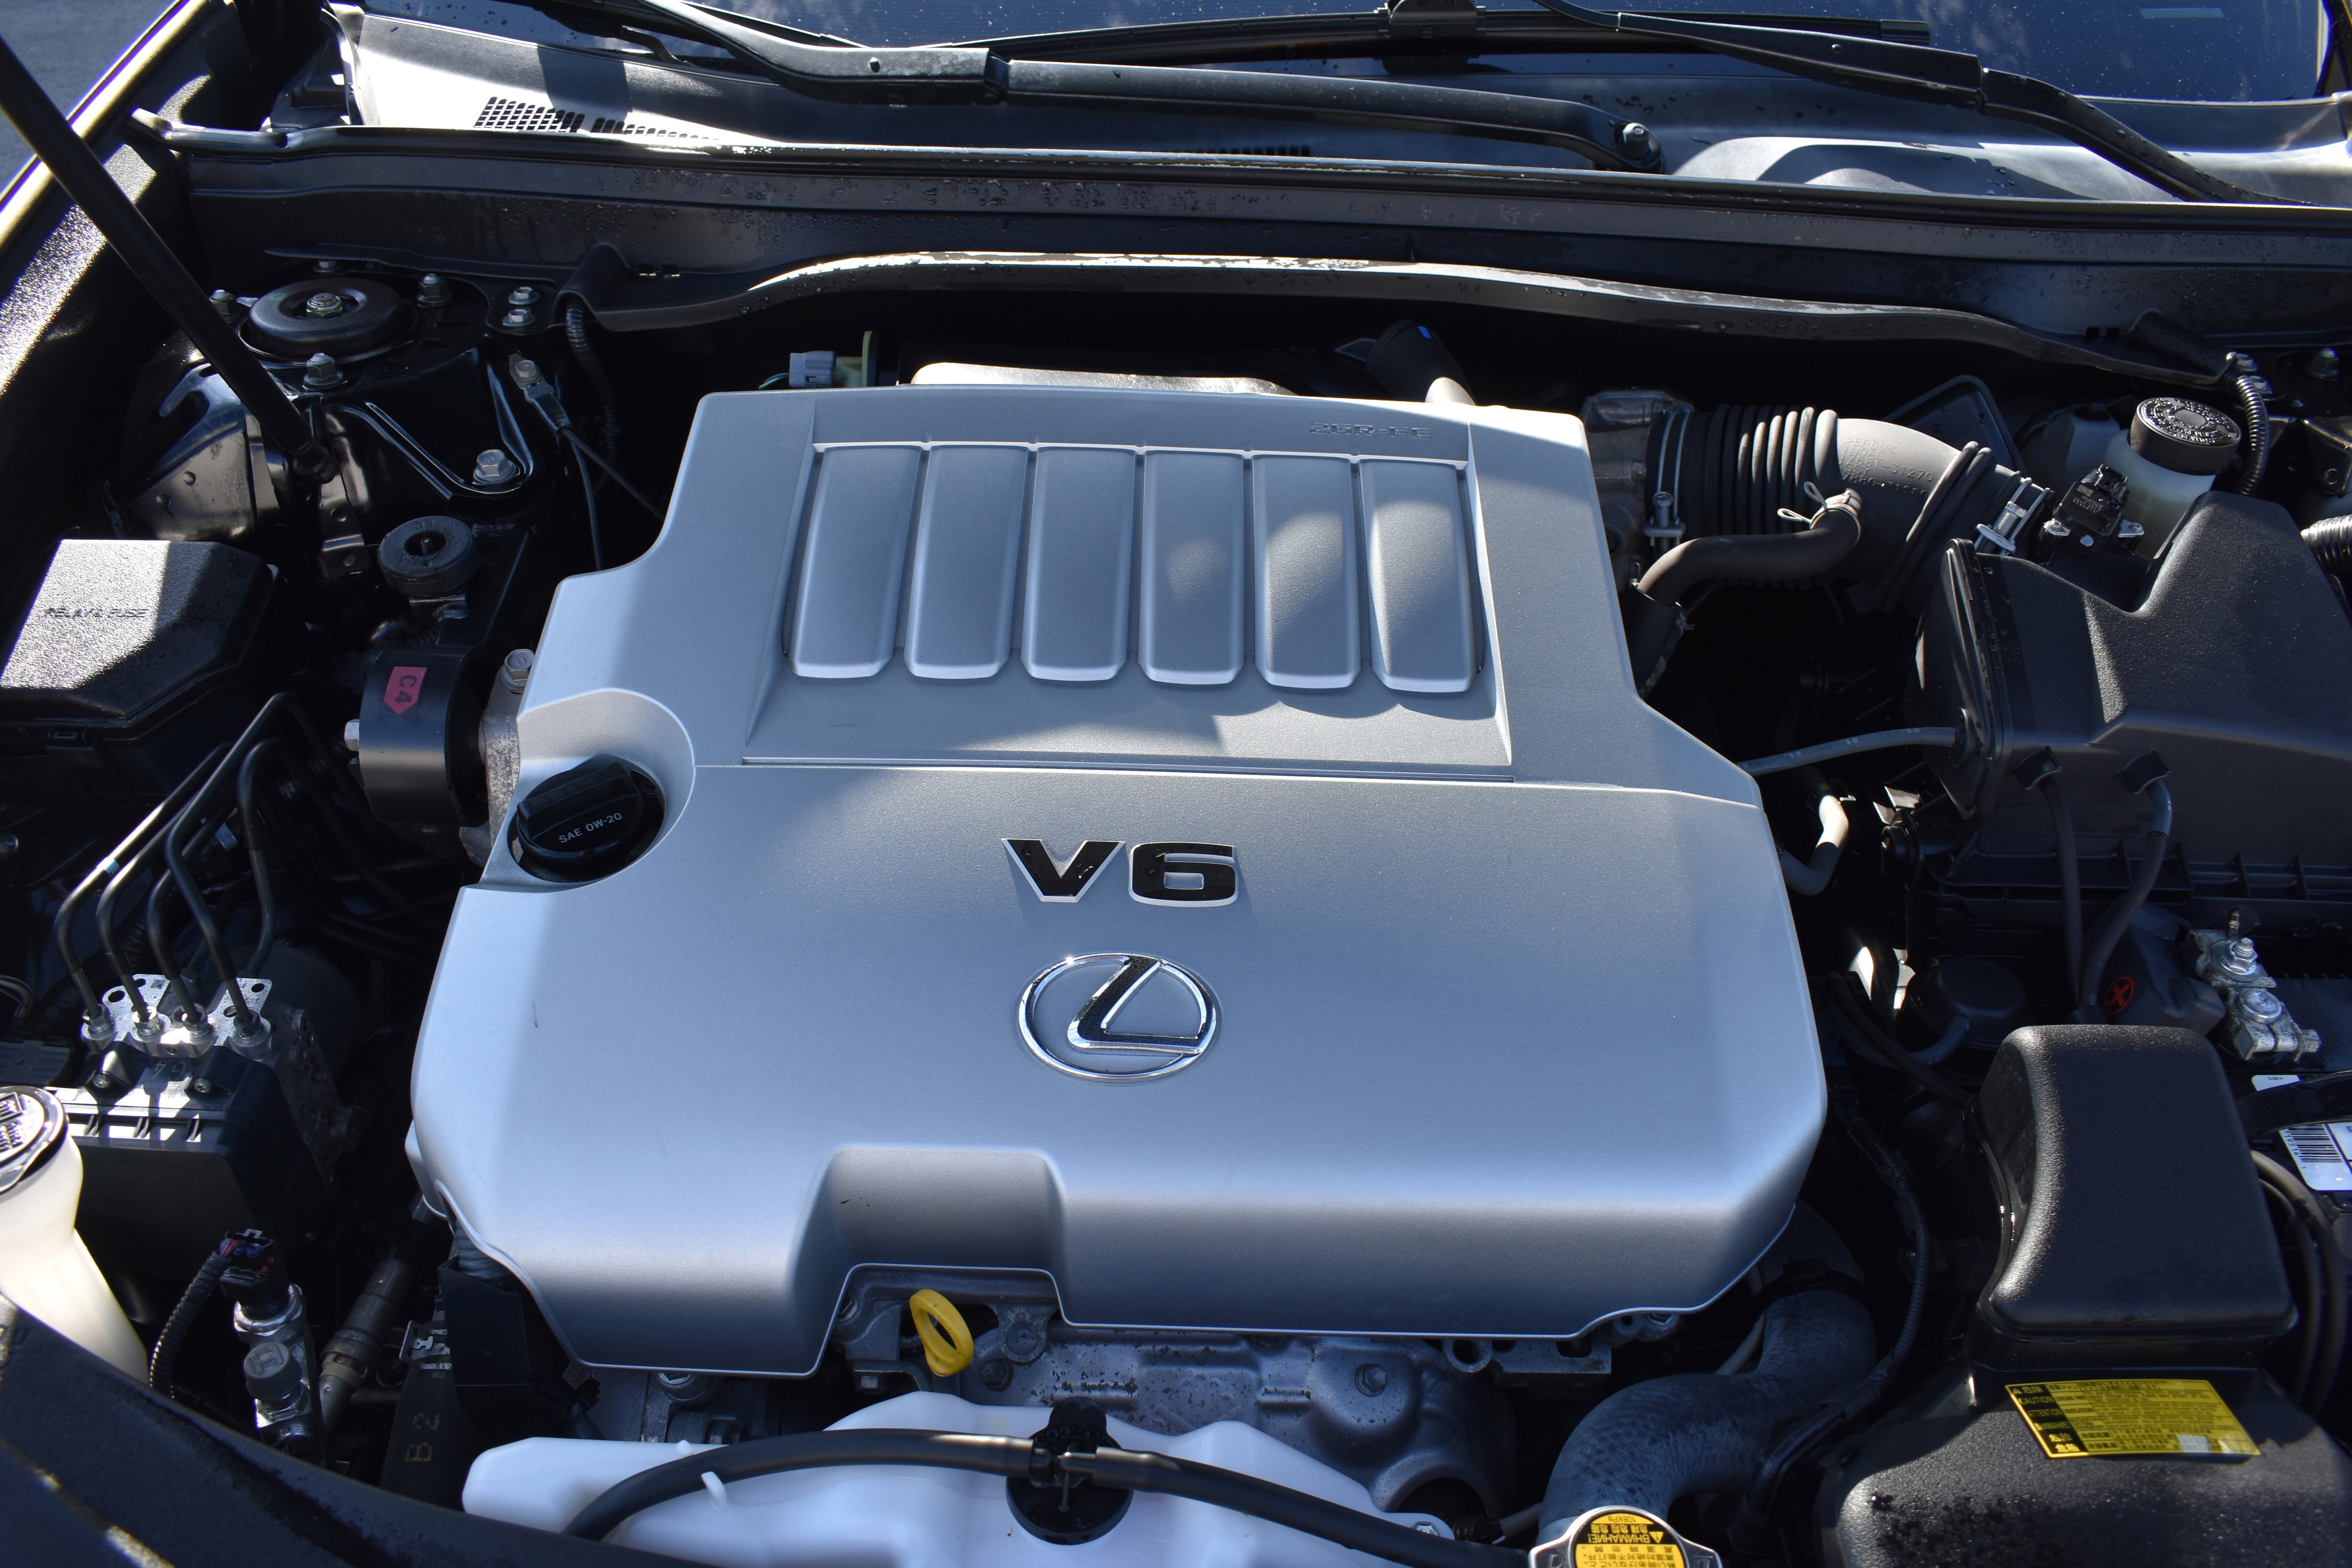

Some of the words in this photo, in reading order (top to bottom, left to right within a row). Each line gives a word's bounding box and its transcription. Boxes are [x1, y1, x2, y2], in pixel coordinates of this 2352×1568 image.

[1310, 422, 1432, 439] 2GR-FE
[559, 827, 583, 844] SAE
[585, 811, 623, 833] 0W-20
[1001, 838, 1239, 907] V6
[248, 1344, 285, 1375] H
[2018, 1395, 2055, 1405] CAUTION
[2027, 1408, 2063, 1417] ATTENTION
[1587, 1533, 1650, 1544] ВНИМАНИЕ!
